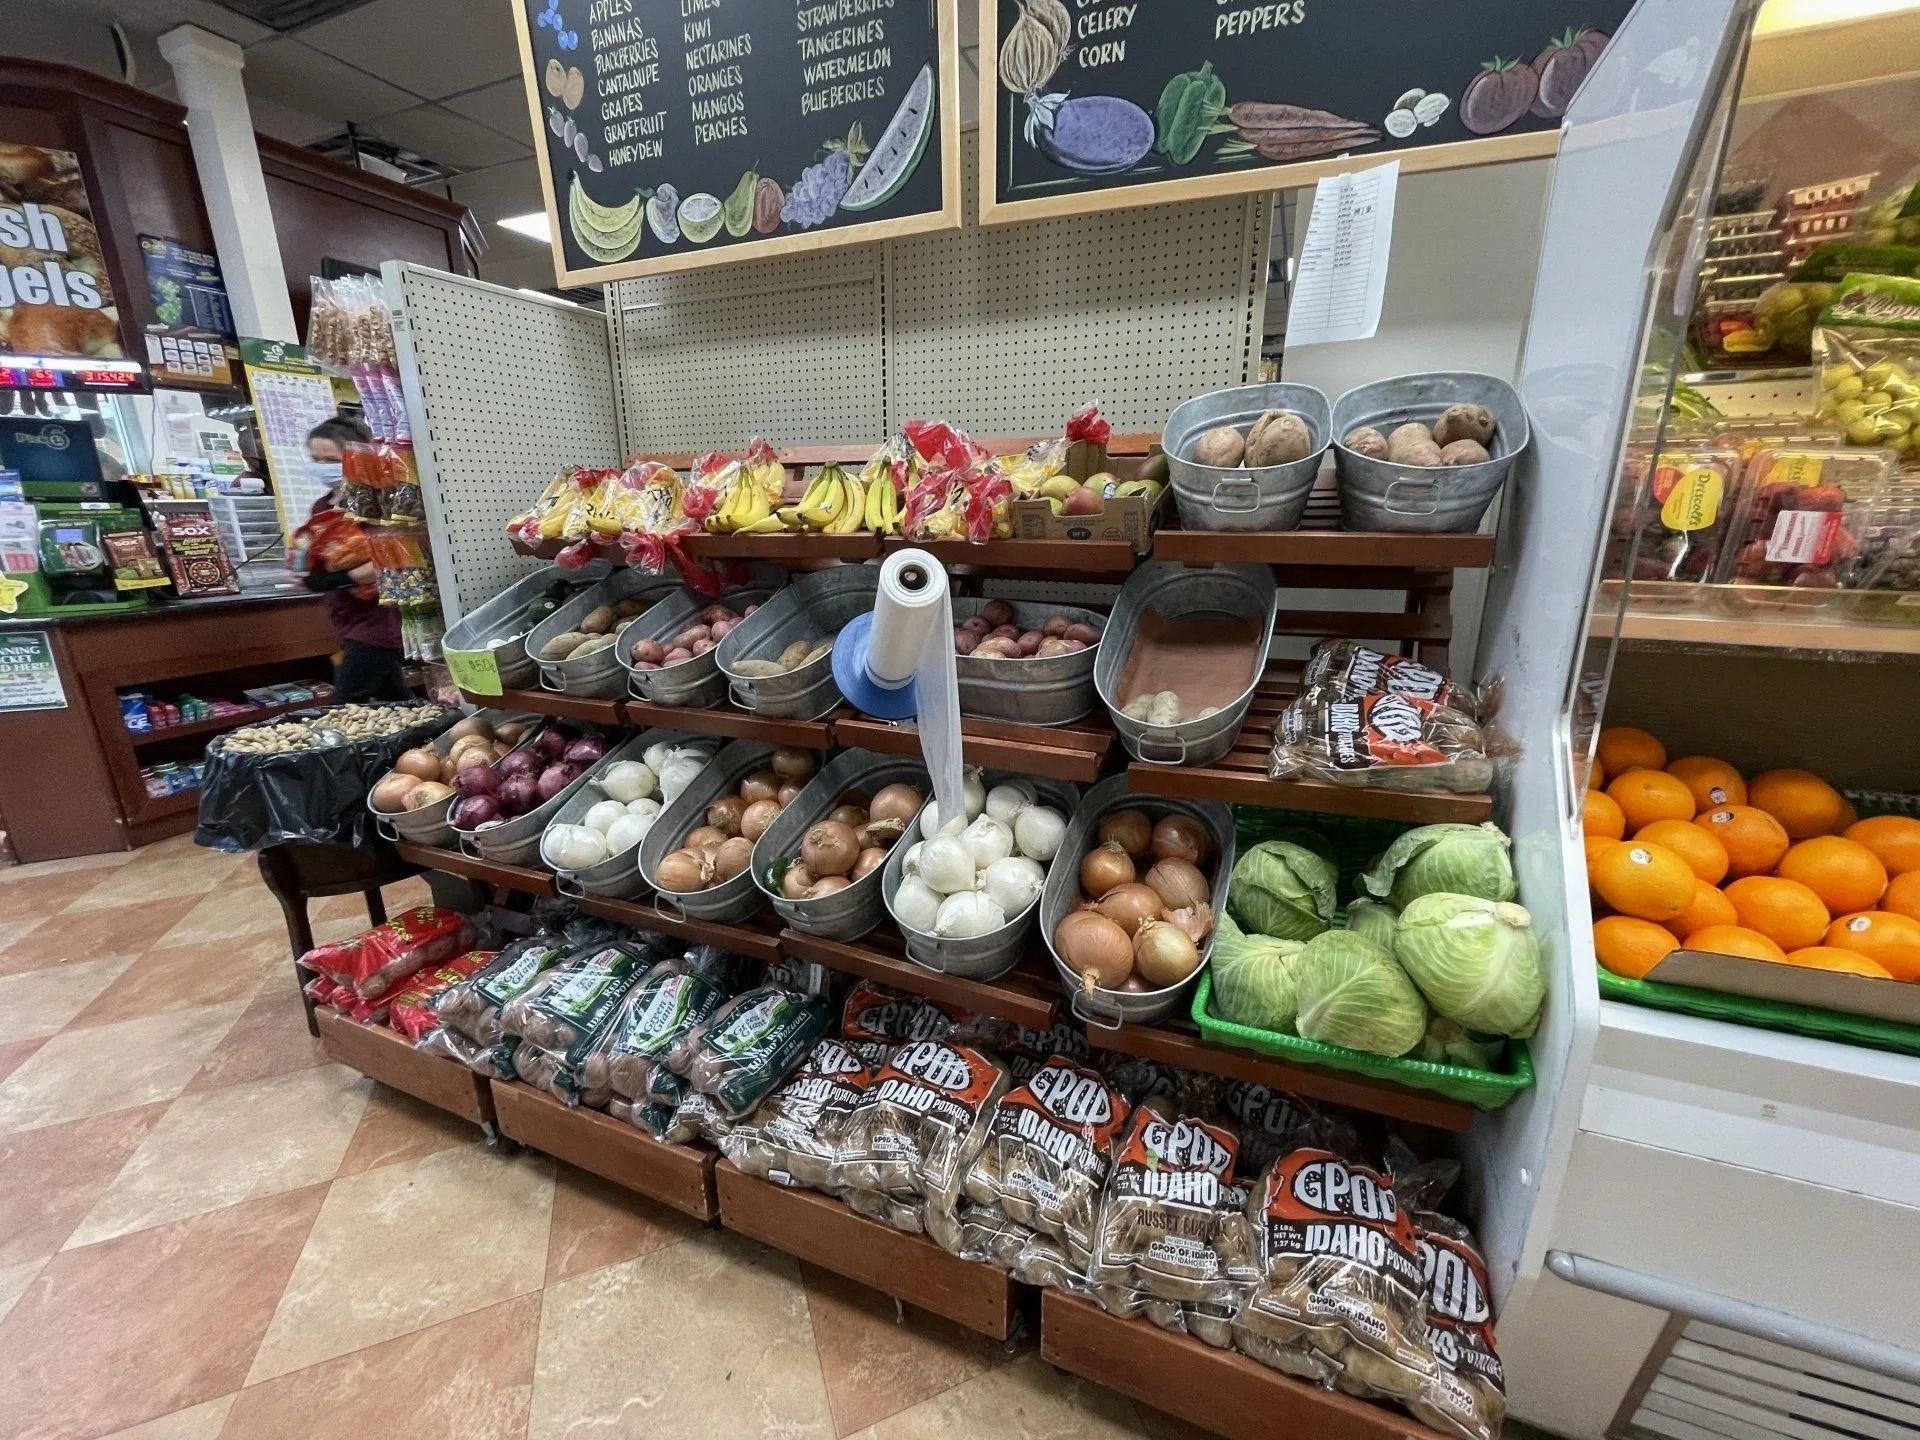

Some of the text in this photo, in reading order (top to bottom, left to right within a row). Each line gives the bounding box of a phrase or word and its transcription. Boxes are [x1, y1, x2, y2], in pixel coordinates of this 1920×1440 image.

[590, 0, 633, 24] APPLES
[1077, 4, 1138, 40] CELERY
[1214, 0, 1306, 40] PEPPERS
[591, 17, 644, 51] BANANAS
[684, 17, 711, 43] KIWI
[797, 19, 884, 61] TANGERINES
[594, 37, 659, 76] BLACKBERRIES
[686, 33, 752, 70] NECTARINES
[803, 46, 891, 87] WATERMELON
[1078, 40, 1126, 68] CORN
[598, 63, 660, 97] CANTALOUPE
[688, 65, 743, 97] ORANGES
[801, 75, 885, 117] BLUEBERRIES
[601, 92, 643, 121] GRAPES
[692, 91, 745, 122] MANGOS
[604, 110, 667, 144] GRAPEFRUIT
[694, 116, 748, 146] PEACHES
[608, 139, 663, 167] HONEYDEW
[602, 979, 622, 998] RED
[643, 1000, 667, 1033] Green
[653, 1001, 676, 1033] Giant
[680, 1009, 698, 1030] RED
[891, 1041, 970, 1090] GPOD
[829, 1085, 862, 1105] POTATOE
[875, 1079, 936, 1111] IDAHO
[932, 1098, 971, 1125] POTATOES
[1028, 1066, 1112, 1124] GPOD
[1017, 1108, 1106, 1178] IDAHO POTATOE
[1143, 1120, 1232, 1176] GPOD
[1041, 1187, 1060, 1202] IDAH
[1144, 1169, 1218, 1206] IDAHO
[1294, 1161, 1397, 1223] GPOD
[1273, 1231, 1304, 1241] NET WT.
[1273, 1239, 1301, 1250] 2.27 kg
[1280, 1225, 1295, 1233] LBS.
[1151, 1242, 1177, 1256] GPOD
[1177, 1247, 1190, 1258] OF
[1177, 1256, 1199, 1268] IDAHO
[1304, 1223, 1424, 1286] IDAHO POTATO
[1309, 1294, 1337, 1310] GPOD
